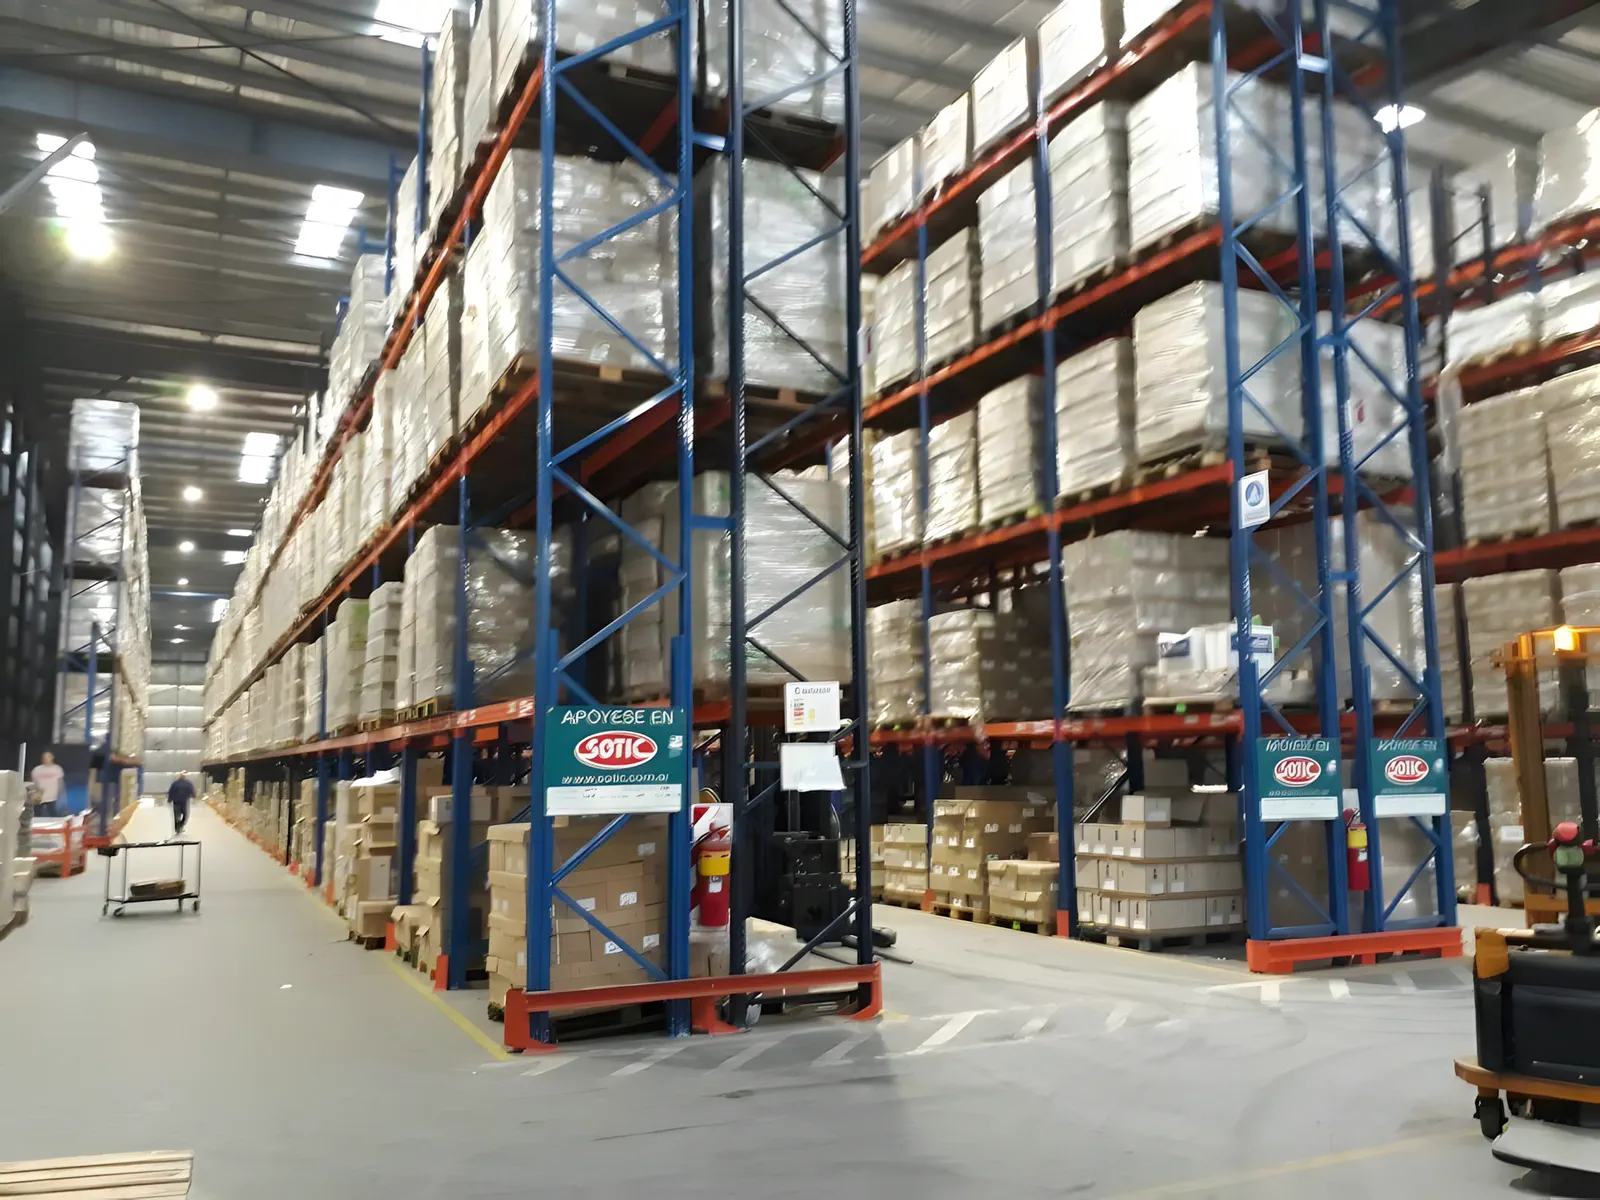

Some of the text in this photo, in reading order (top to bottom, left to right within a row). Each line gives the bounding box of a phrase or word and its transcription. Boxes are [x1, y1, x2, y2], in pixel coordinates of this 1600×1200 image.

[561, 709, 674, 725] APOYESE EN
[578, 737, 654, 760] SOTIC
